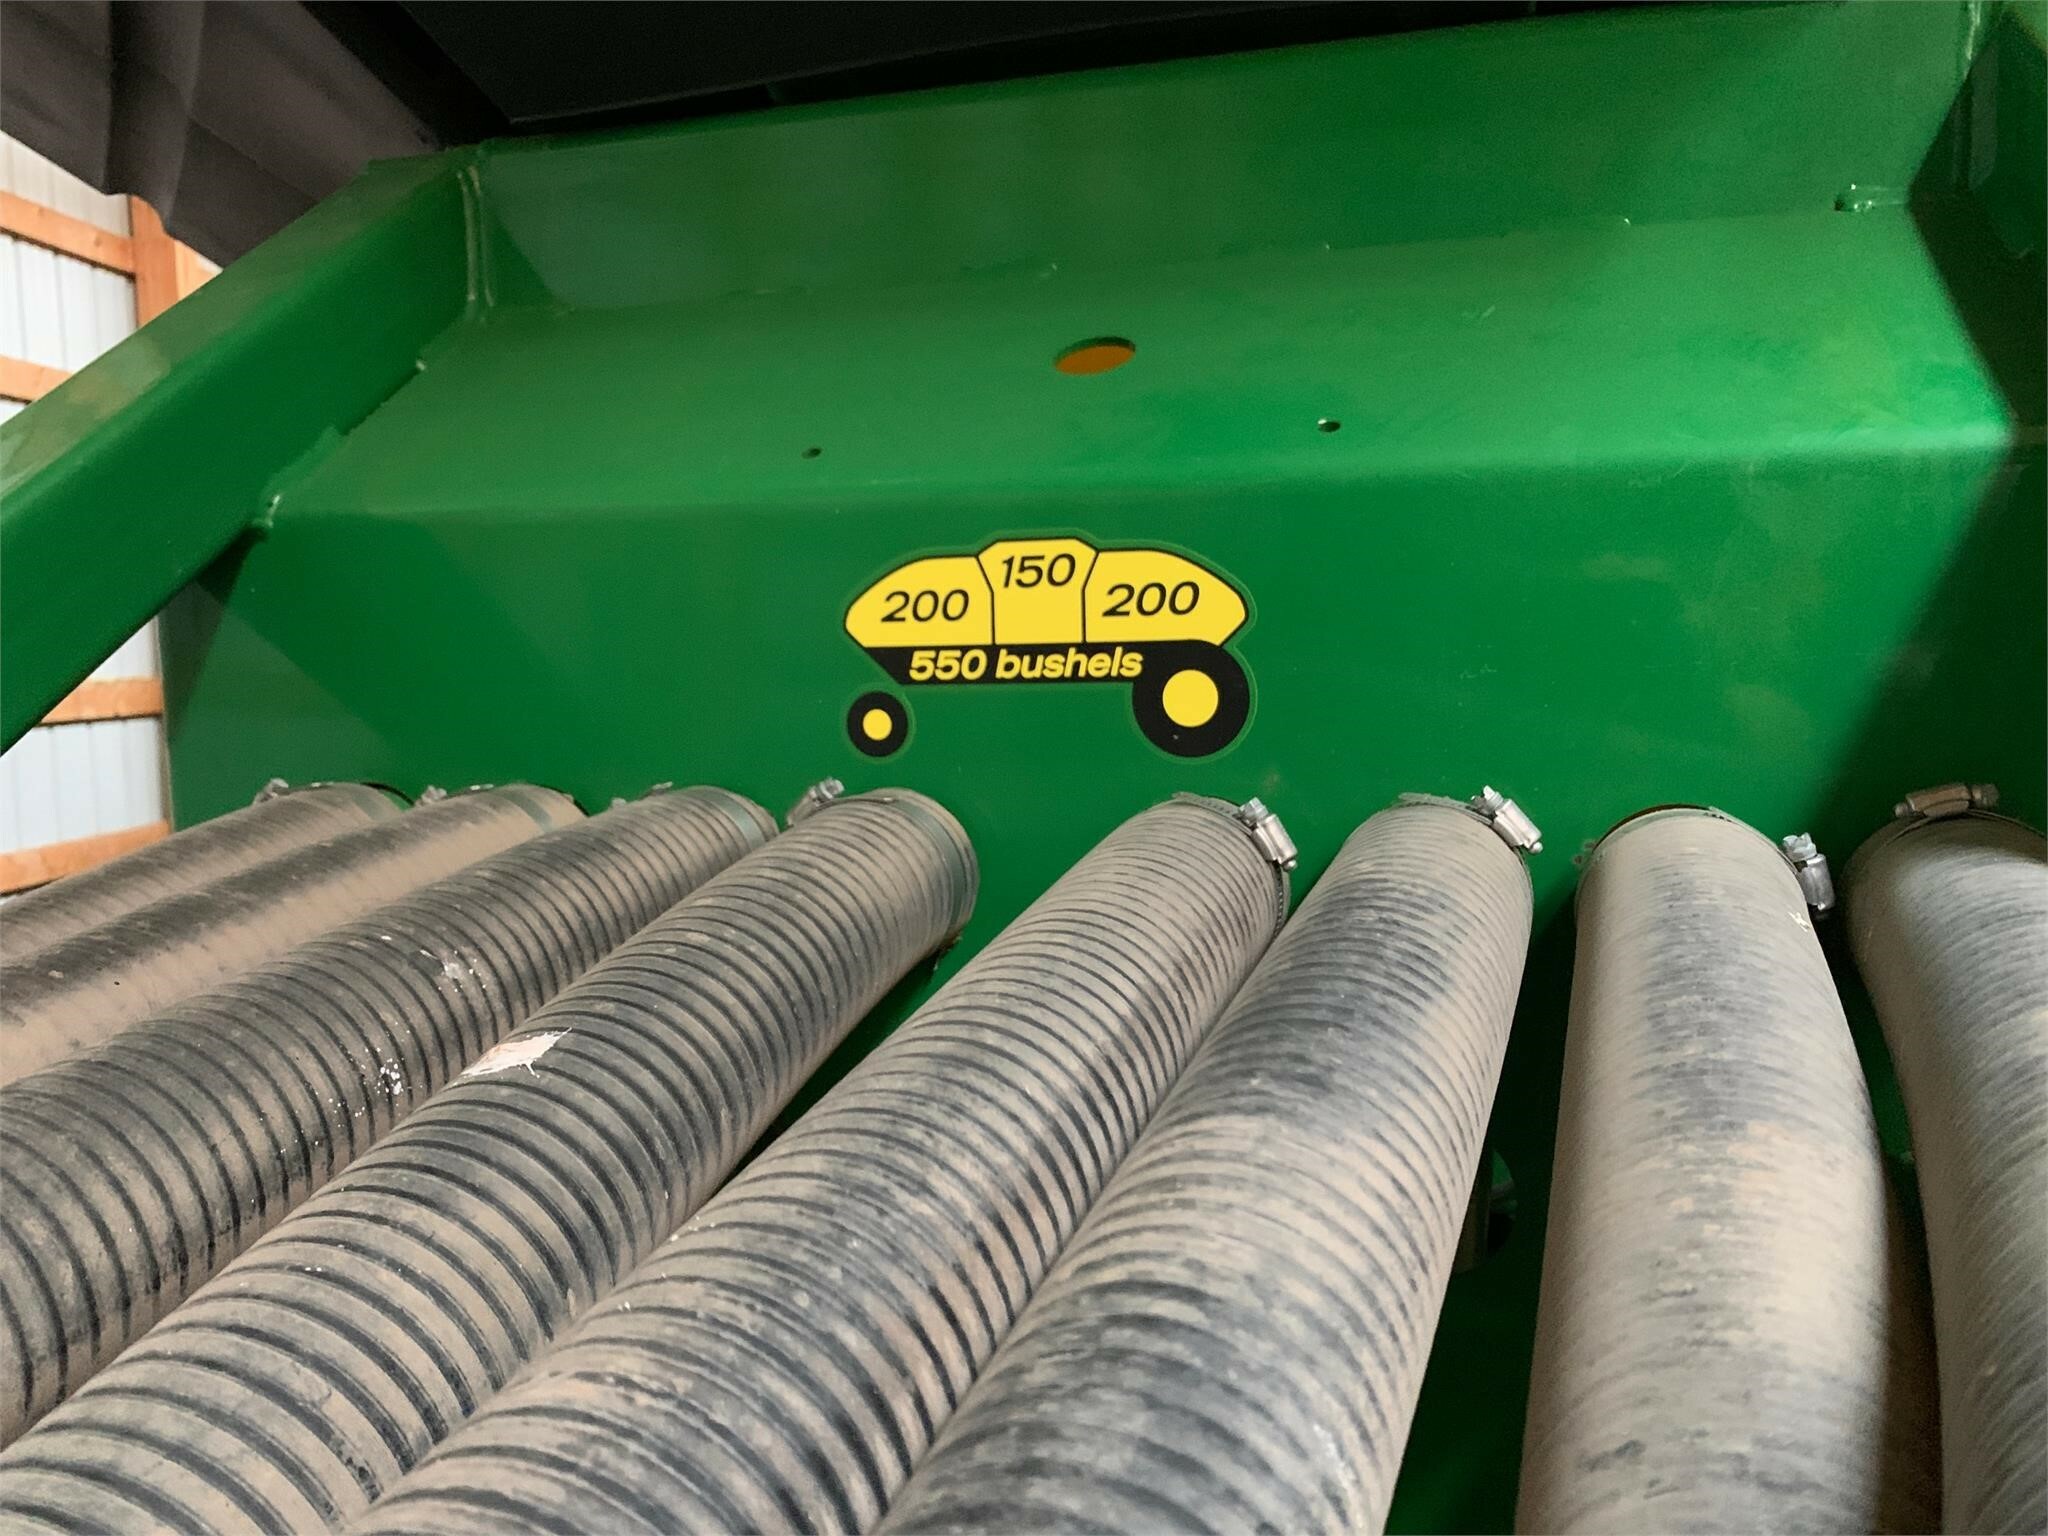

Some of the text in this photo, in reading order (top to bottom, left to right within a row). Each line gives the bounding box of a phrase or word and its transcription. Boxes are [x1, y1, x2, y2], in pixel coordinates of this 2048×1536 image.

[1002, 553, 1076, 588] 150
[880, 589, 969, 622] 200
[1102, 581, 1200, 617] 200
[909, 646, 1144, 681] 550 bushels
